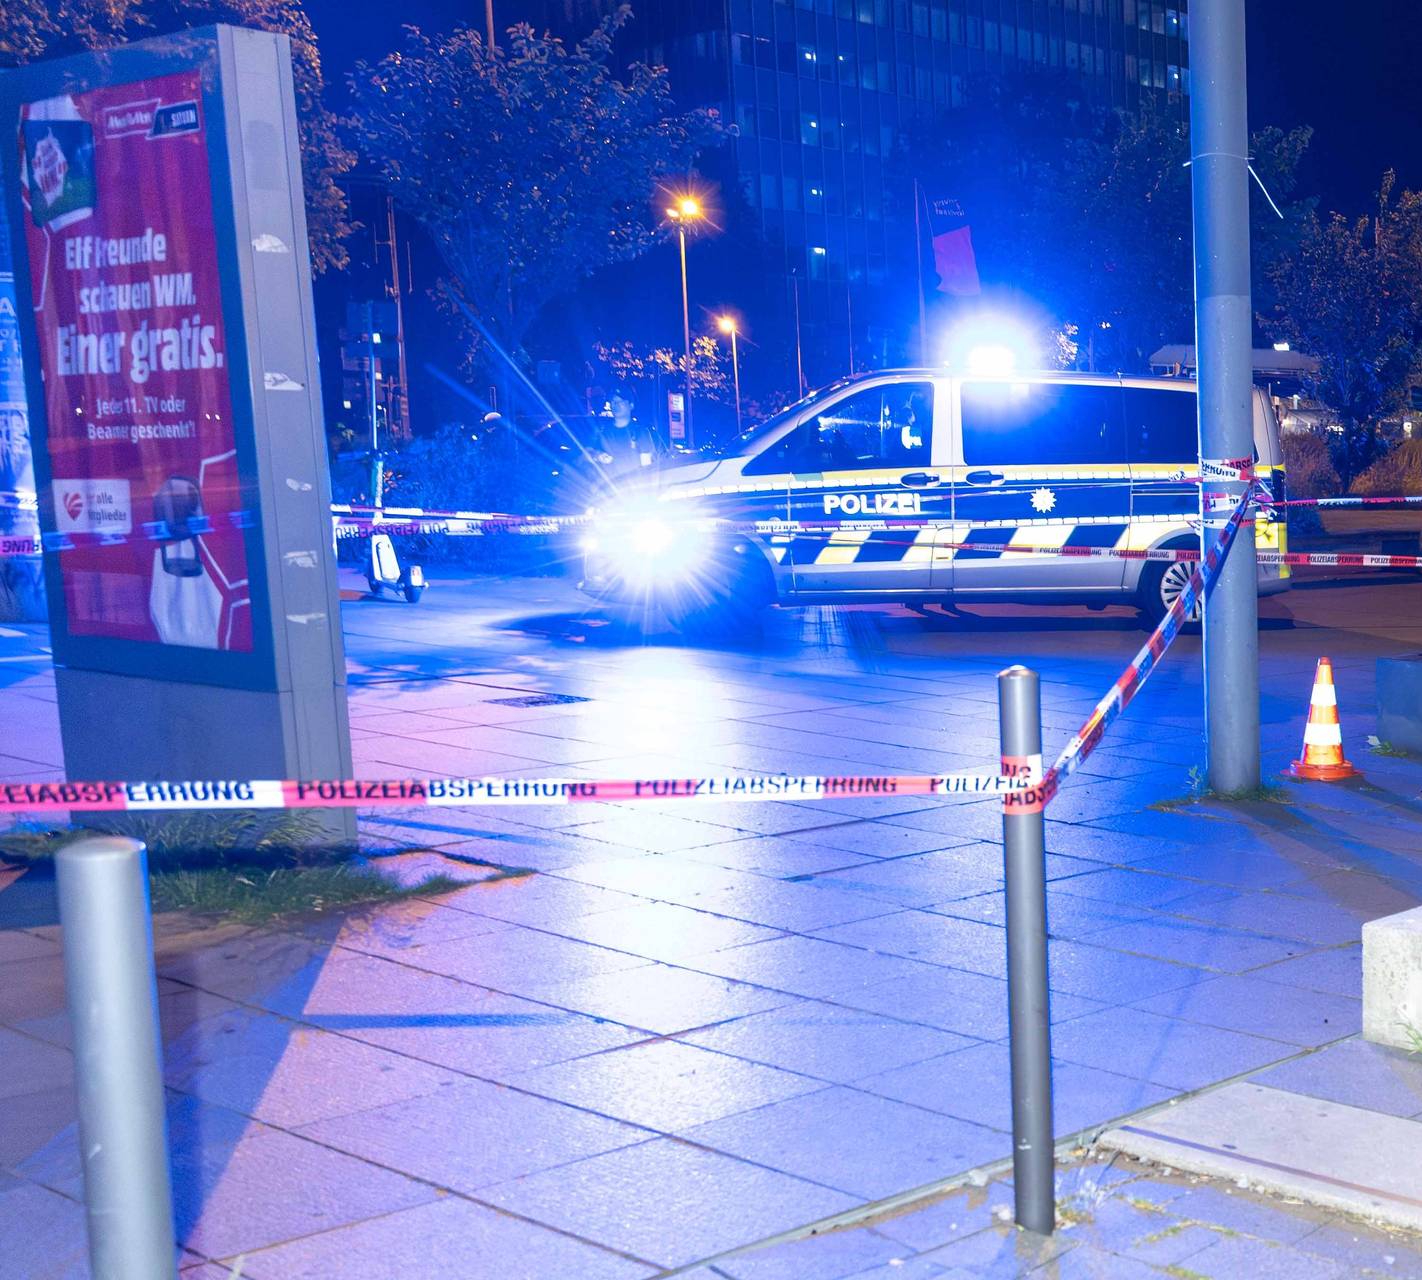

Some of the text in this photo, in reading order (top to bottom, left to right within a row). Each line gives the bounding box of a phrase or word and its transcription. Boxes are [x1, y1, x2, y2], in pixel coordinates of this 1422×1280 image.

[65, 236, 93, 270] Elf
[79, 272, 197, 314] schauen WM.
[57, 313, 224, 384] Einer gratis.
[125, 398, 142, 414] 11.
[143, 396, 158, 413] TV
[160, 395, 186, 413] oder
[87, 422, 129, 440] Beamer
[96, 491, 114, 504] alle
[823, 493, 921, 515] POLIZEI
